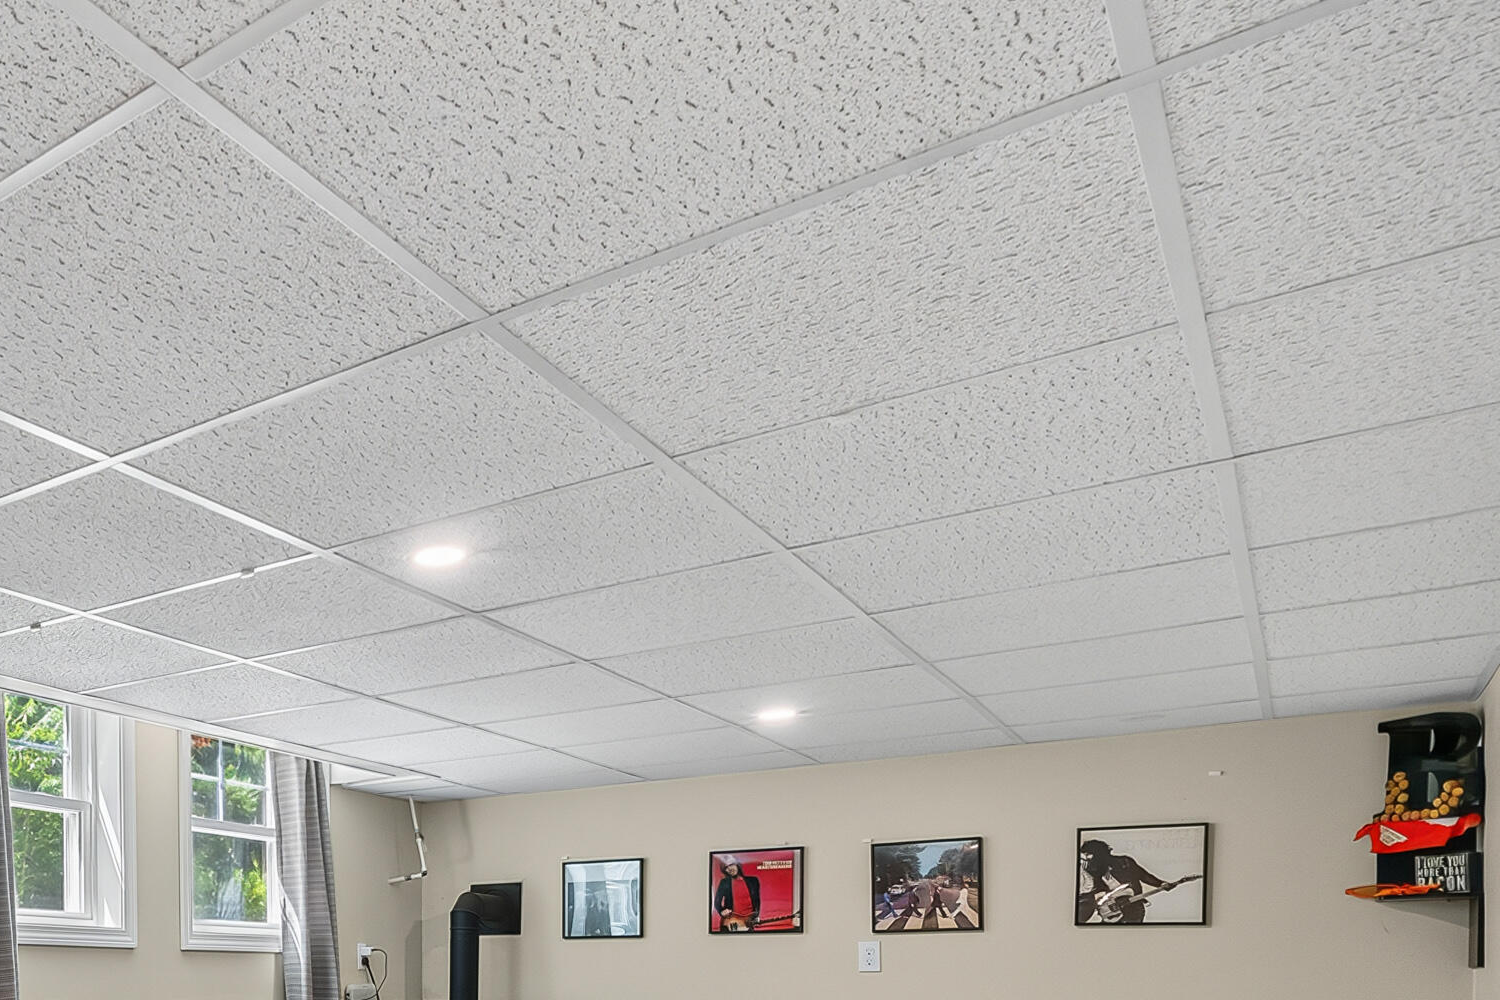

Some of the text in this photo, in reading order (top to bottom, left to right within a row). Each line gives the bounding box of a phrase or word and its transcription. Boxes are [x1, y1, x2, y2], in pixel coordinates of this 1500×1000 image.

[1422, 856, 1445, 869] LOVE
[1447, 855, 1465, 867] YOU
[1417, 866, 1466, 877] MORE THAN
